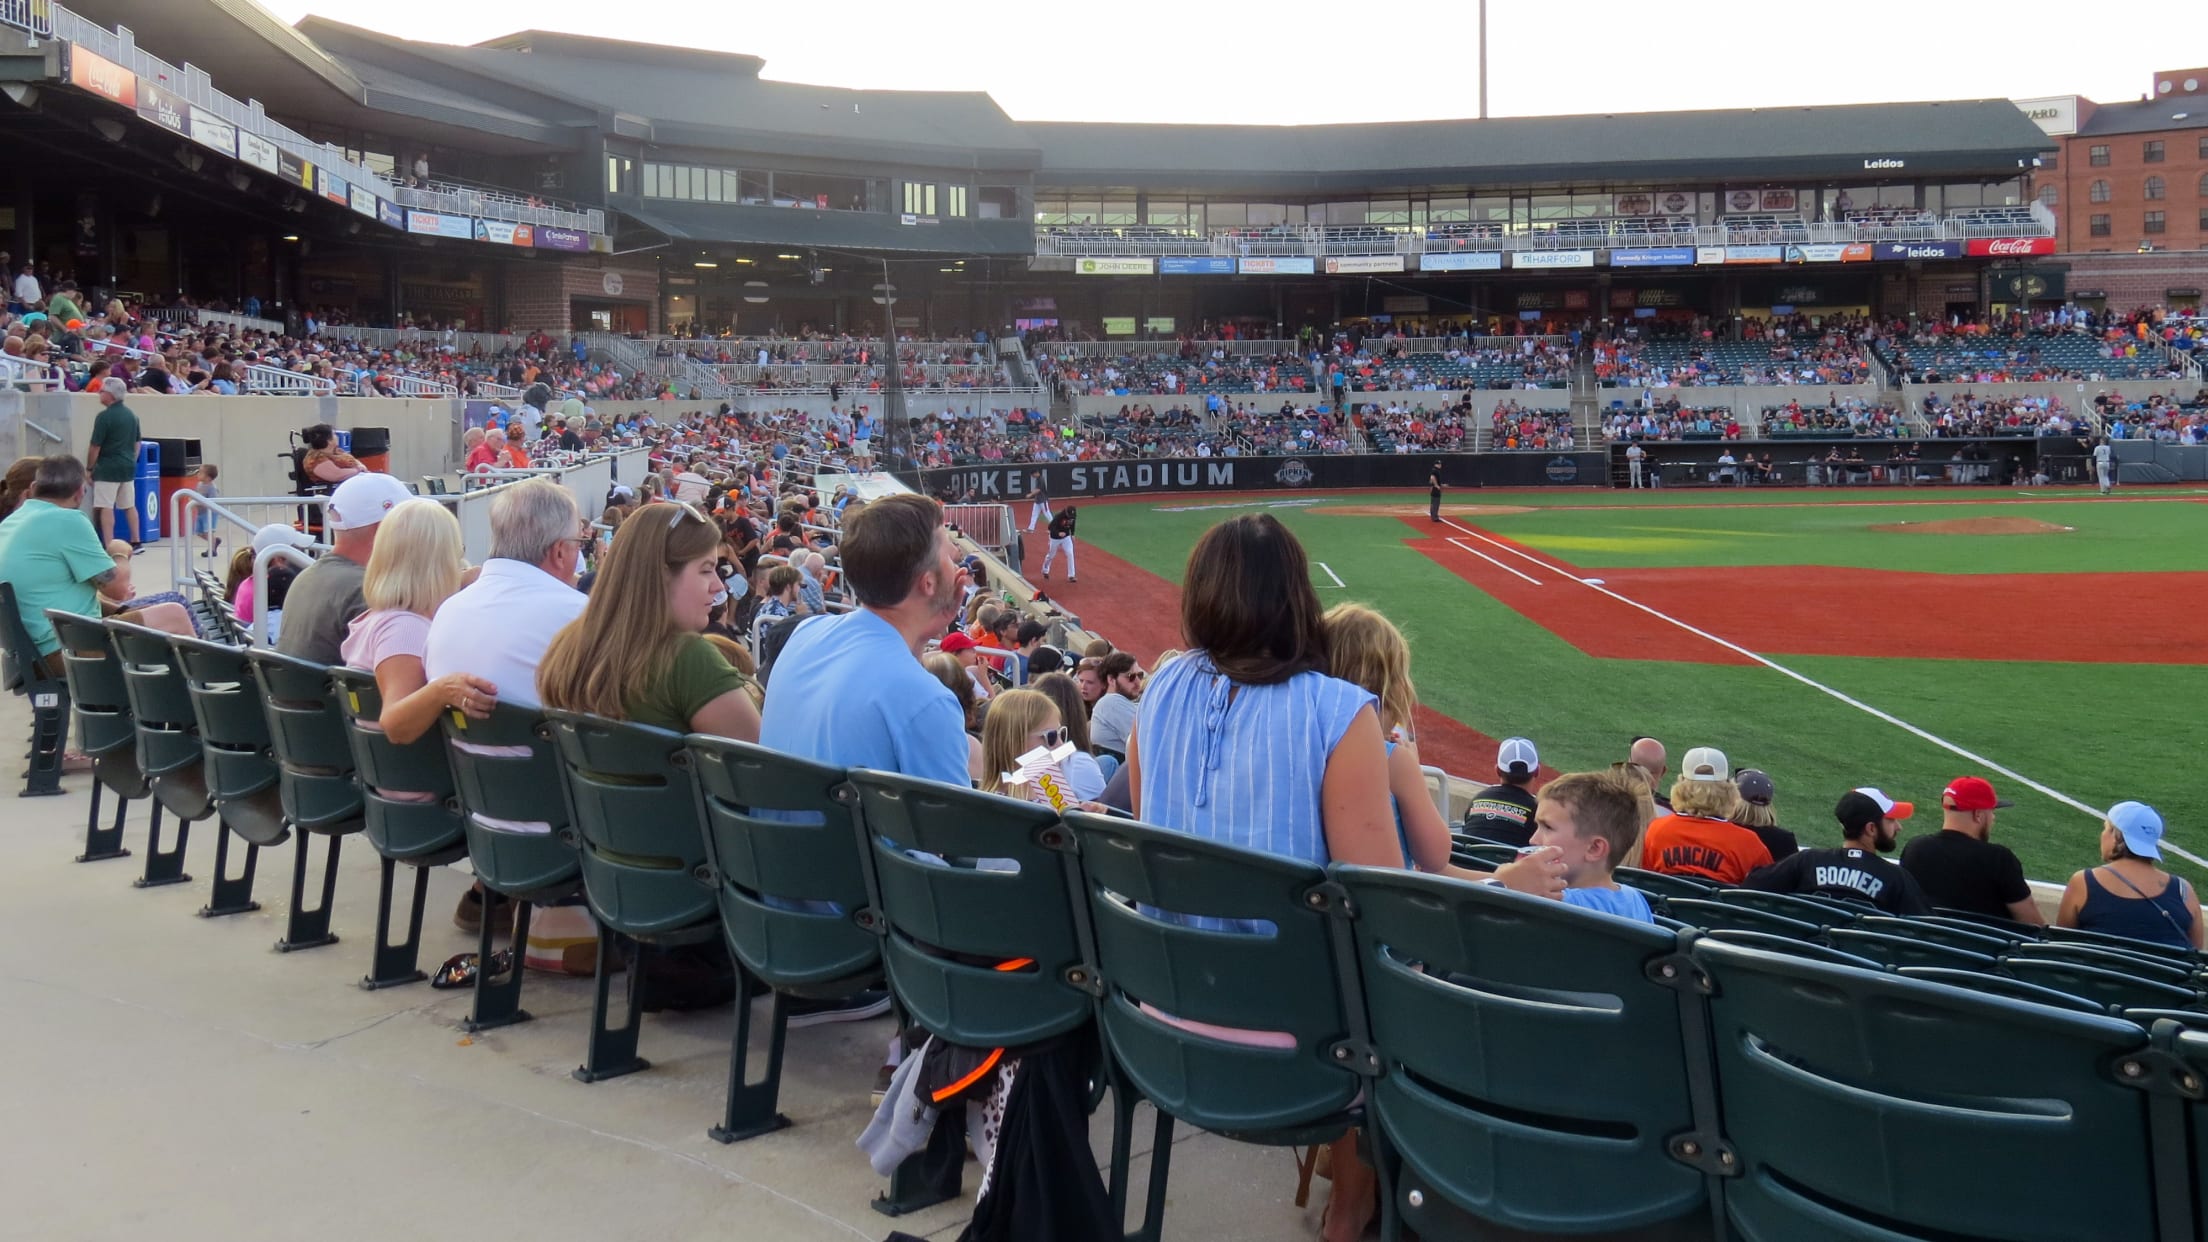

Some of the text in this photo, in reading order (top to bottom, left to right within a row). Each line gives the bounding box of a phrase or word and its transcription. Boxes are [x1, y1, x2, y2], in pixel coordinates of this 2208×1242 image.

[158, 98, 181, 129] leidos
[1864, 159, 1904, 169] Leidos
[1532, 254, 1582, 264] HARFORD
[1907, 247, 1945, 258] leidos
[1071, 463, 1234, 491] STADIUM
[1815, 866, 1883, 898] BOOMER
